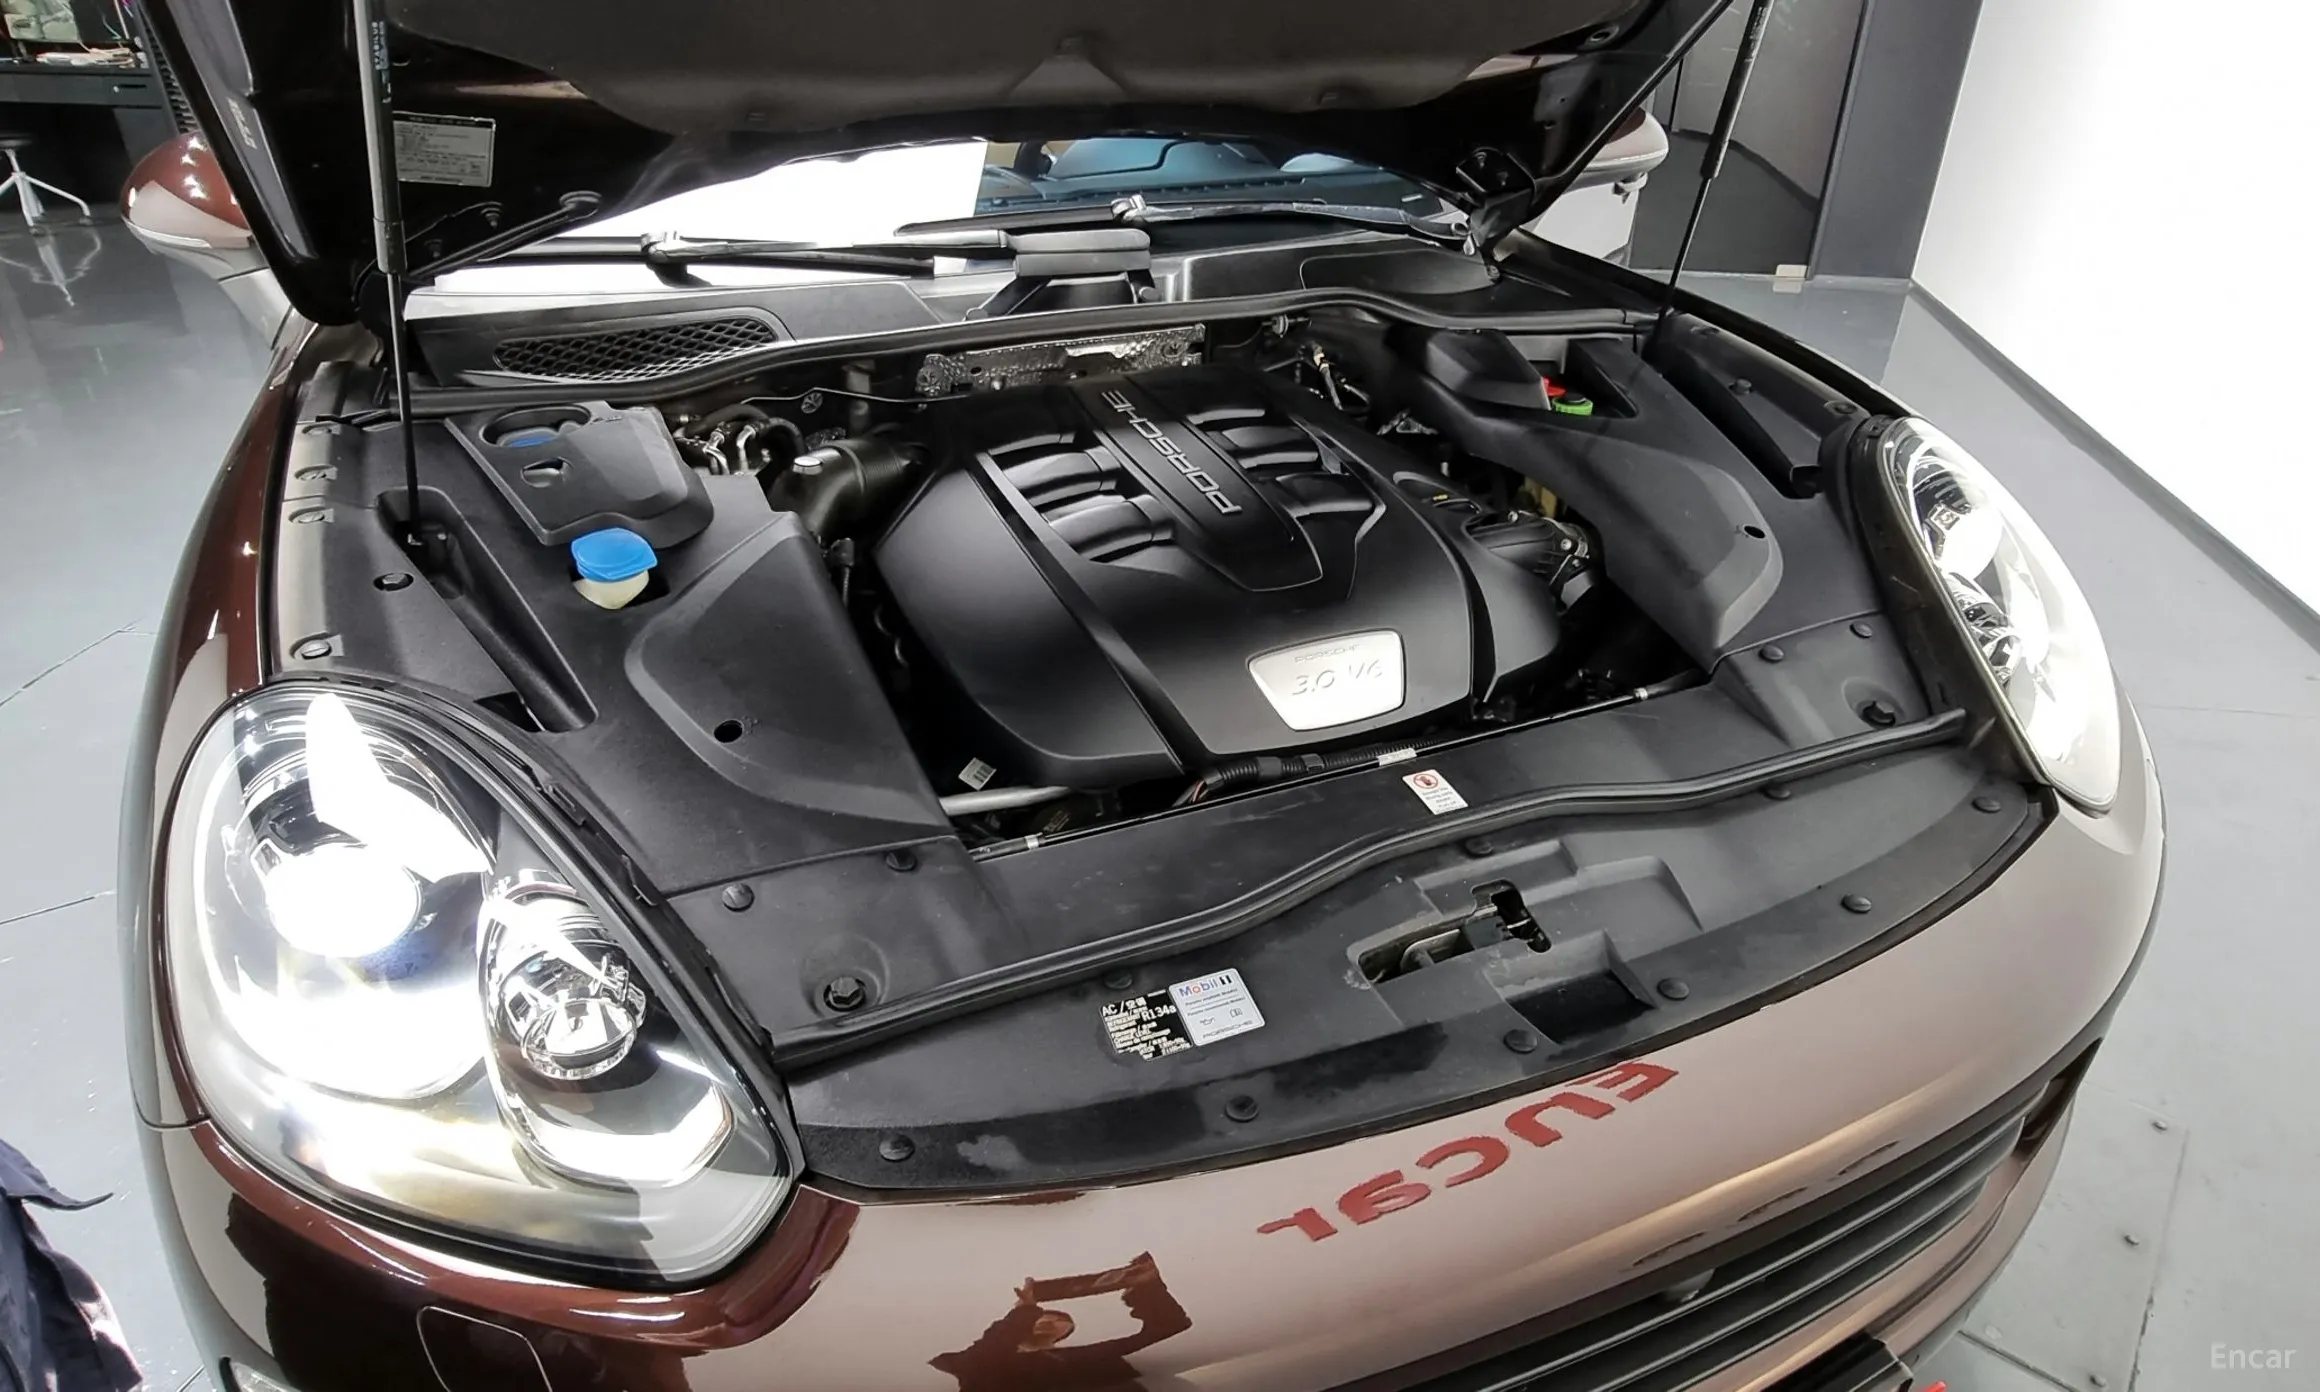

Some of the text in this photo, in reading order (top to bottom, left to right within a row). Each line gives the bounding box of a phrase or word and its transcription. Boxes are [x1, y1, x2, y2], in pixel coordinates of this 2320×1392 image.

[1101, 390, 1243, 514] PORSCHE
[1292, 659, 1383, 696] 3.0 V6
[1179, 979, 1219, 997] Mobil
[1102, 1004, 1117, 1017] AC
[1141, 1005, 1177, 1021] R134a
